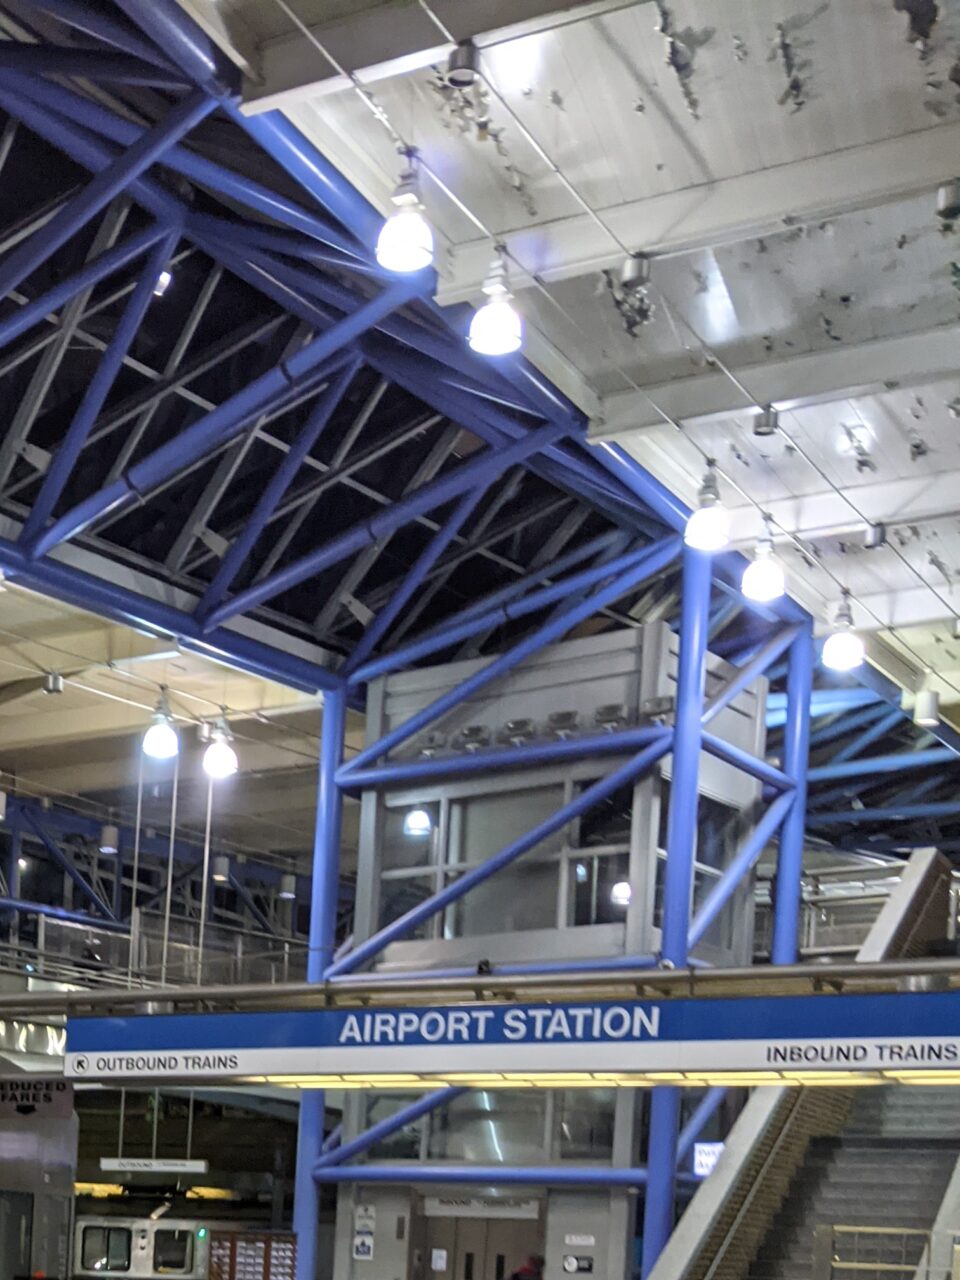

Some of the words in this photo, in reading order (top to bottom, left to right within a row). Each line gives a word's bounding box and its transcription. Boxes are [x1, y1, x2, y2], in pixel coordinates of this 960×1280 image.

[339, 1010, 494, 1043] AIRPORT
[502, 1005, 661, 1040] STATION
[766, 1045, 869, 1063] INBOUND
[874, 1043, 958, 1061] TRAINS
[96, 1057, 178, 1071] OUTBOUND
[183, 1055, 238, 1070] TRAINS
[1, 1092, 53, 1103] FARES
